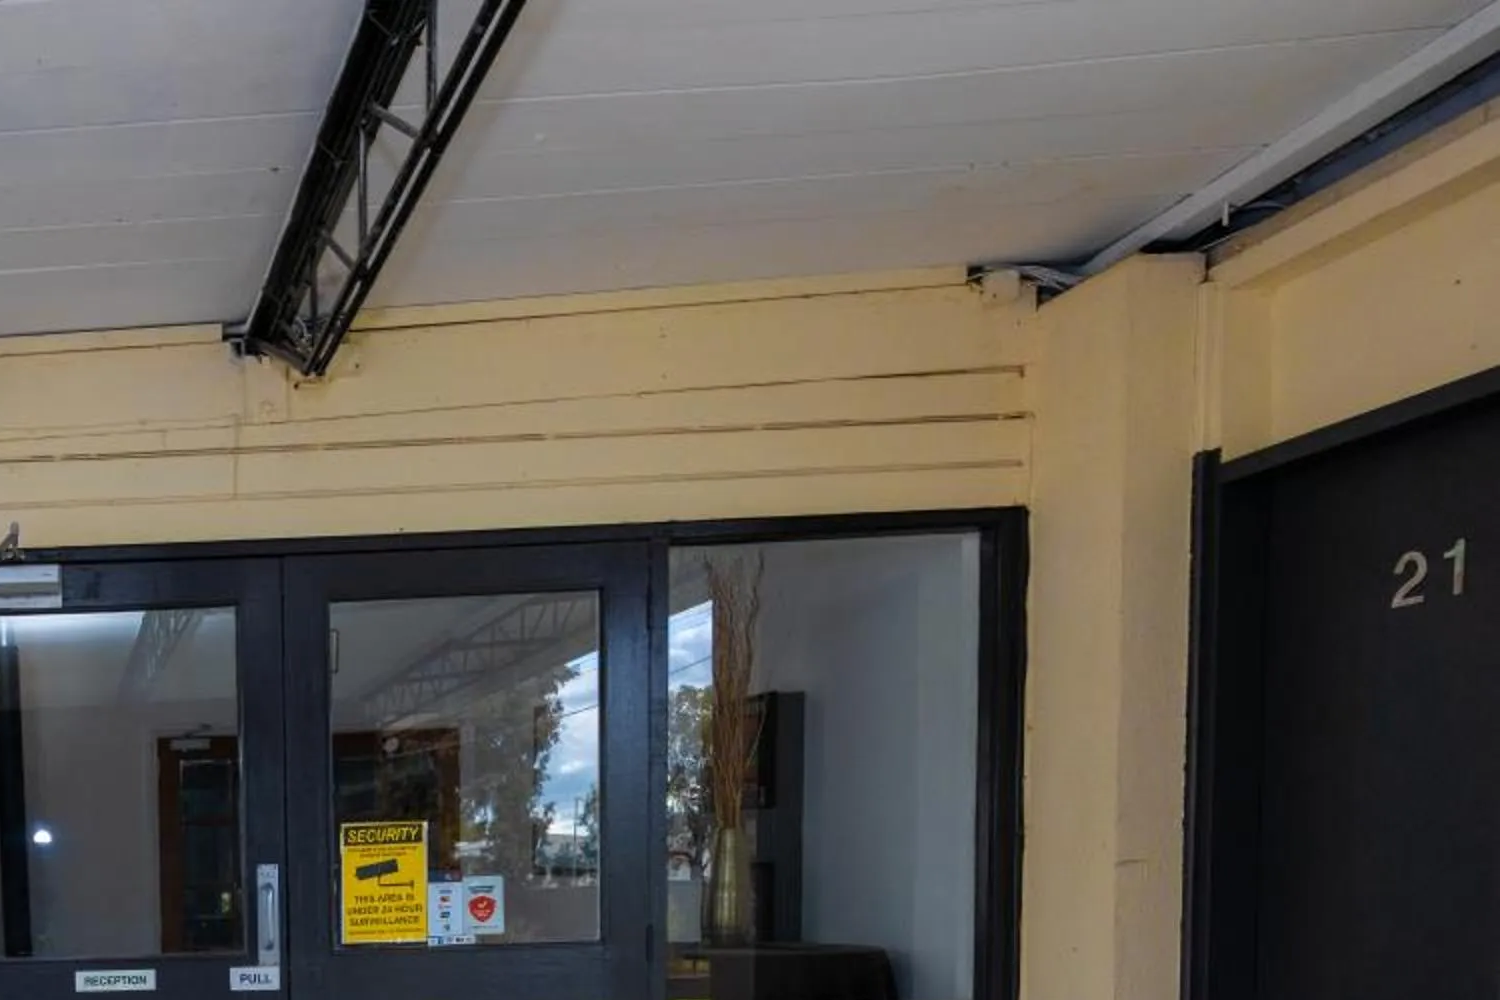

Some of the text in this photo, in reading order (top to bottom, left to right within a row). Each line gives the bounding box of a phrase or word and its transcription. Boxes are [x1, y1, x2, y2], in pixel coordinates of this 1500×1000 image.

[1391, 538, 1466, 608] 21
[347, 827, 419, 843] SECURITY
[354, 895, 375, 904] THIS
[378, 894, 403, 903] AREA
[394, 905, 423, 914] HOUR
[349, 916, 420, 927] SURVEILLANCE
[83, 975, 148, 987] RECEPTION
[239, 973, 273, 984] PULL
